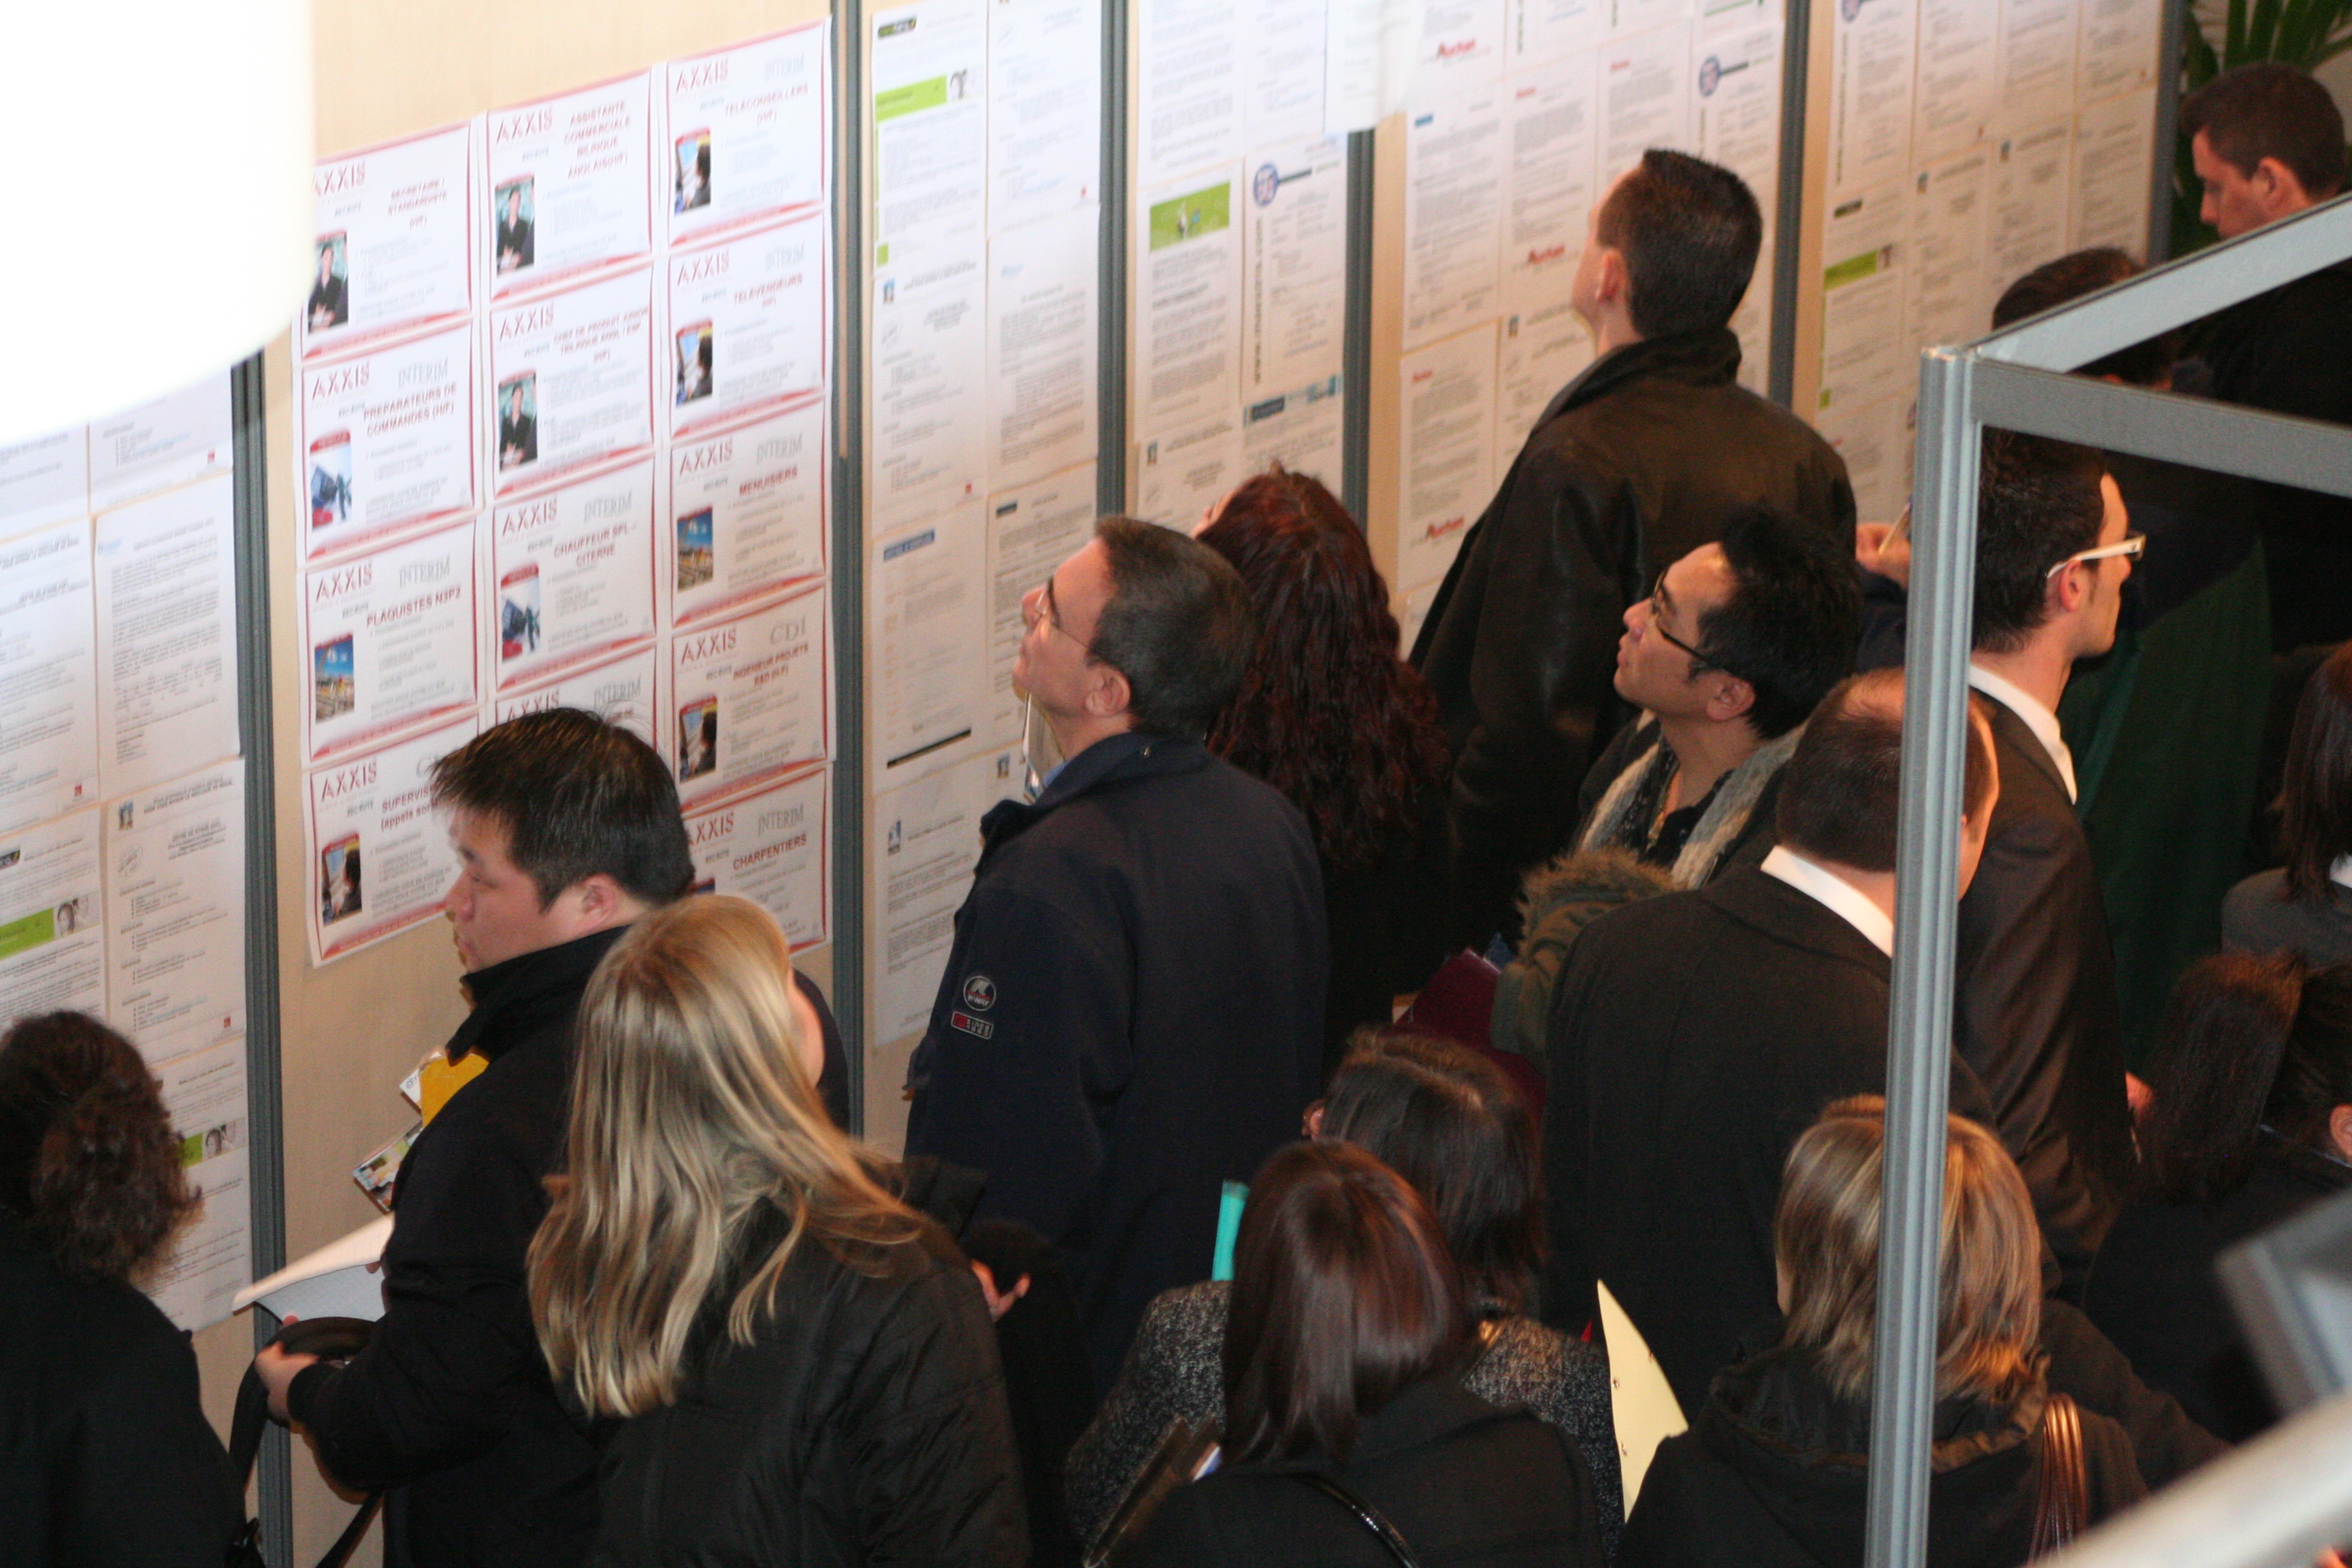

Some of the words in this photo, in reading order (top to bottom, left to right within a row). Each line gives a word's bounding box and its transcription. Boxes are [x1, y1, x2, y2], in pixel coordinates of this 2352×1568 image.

[676, 56, 728, 94] AXXIS
[496, 105, 553, 144] AXXIS
[677, 248, 730, 286] AXXIS
[499, 301, 554, 342] AXXIS
[312, 361, 370, 401] AXXIS
[398, 356, 448, 389] INTERIM
[363, 385, 441, 422] PREPARATEURS
[367, 407, 429, 438] COMMANDES
[680, 437, 733, 476] AXXIS
[757, 431, 802, 464] INTERIM
[739, 463, 798, 497] MENUISIERS
[502, 495, 557, 536] AXXIS
[584, 490, 632, 523] INTERIM
[554, 526, 610, 558] CHAUFFEUR
[576, 543, 615, 567] CITERNE
[316, 559, 372, 603] AXXIS
[399, 555, 451, 589] INTERIM
[367, 594, 432, 630] PLAQUISTES
[770, 615, 806, 644] CDI
[681, 626, 736, 665] AXXIS
[593, 674, 641, 710] INTERIM
[321, 757, 377, 803] AXXIS
[382, 783, 438, 813] SUPERVIS
[758, 803, 804, 836] INTERIM
[733, 832, 807, 870] CHARPENTIERS
